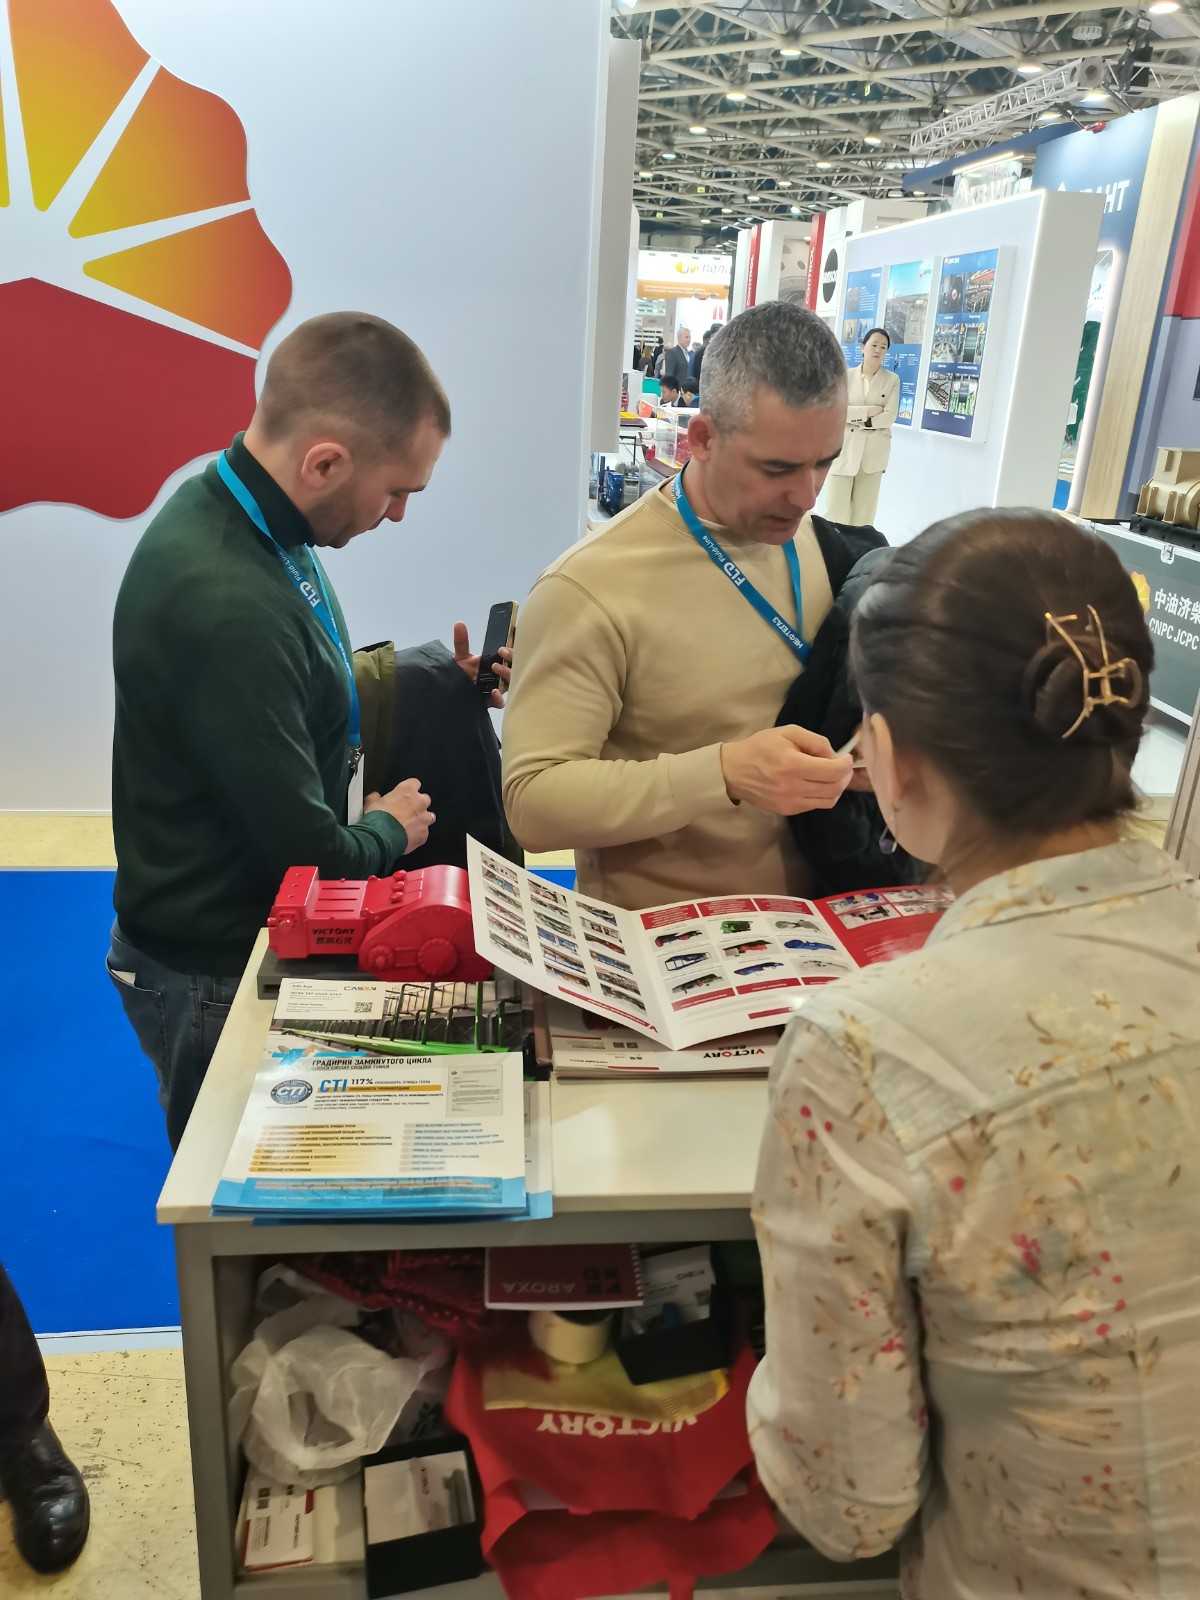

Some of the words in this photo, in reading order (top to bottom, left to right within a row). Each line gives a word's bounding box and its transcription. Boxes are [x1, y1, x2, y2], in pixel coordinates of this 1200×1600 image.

[723, 561, 746, 586] FLD
[299, 581, 321, 608] FLD
[772, 616, 804, 649] НЕФТЕГАЗ
[1149, 617, 1175, 640] CNPC
[1174, 628, 1199, 651] JCPC
[312, 1059, 352, 1067] ГРАДИРНЯ
[354, 1058, 404, 1066] ЗАМКНУТОГО
[406, 1057, 432, 1065] ЦИКЛА
[703, 1048, 765, 1058] VICTORY
[319, 1079, 348, 1093] CTI
[502, 1281, 576, 1294] AROXA
